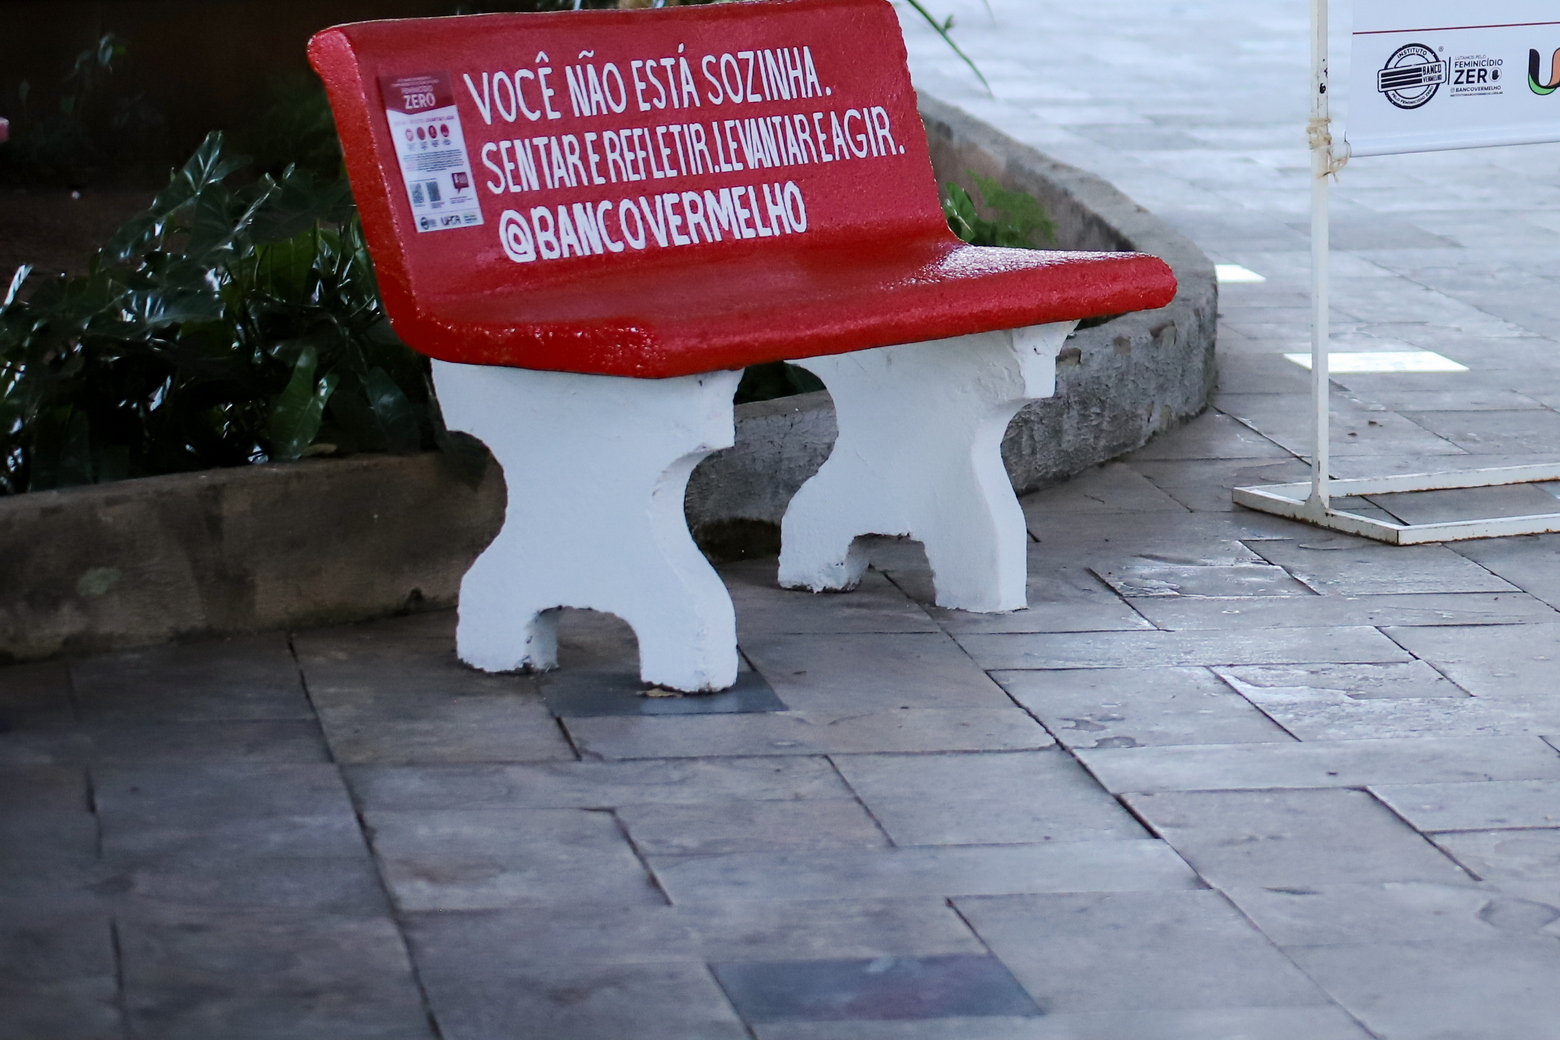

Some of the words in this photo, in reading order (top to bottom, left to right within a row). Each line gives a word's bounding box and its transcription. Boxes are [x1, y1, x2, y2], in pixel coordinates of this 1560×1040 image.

[1397, 48, 1428, 58] INSTITUTO
[1455, 58, 1503, 68] FEMINICÍDIO
[403, 93, 436, 109] ZERO
[463, 50, 562, 125] VOCÊ
[565, 49, 627, 117] NÃO
[631, 42, 700, 111] ESTÁ
[701, 46, 832, 105] SOZINHA.
[481, 134, 588, 194] SENTAR
[584, 132, 606, 185] E
[812, 112, 833, 163] E
[830, 105, 905, 160] AGIR.
[499, 180, 807, 263] @BANCOVERMELHO
